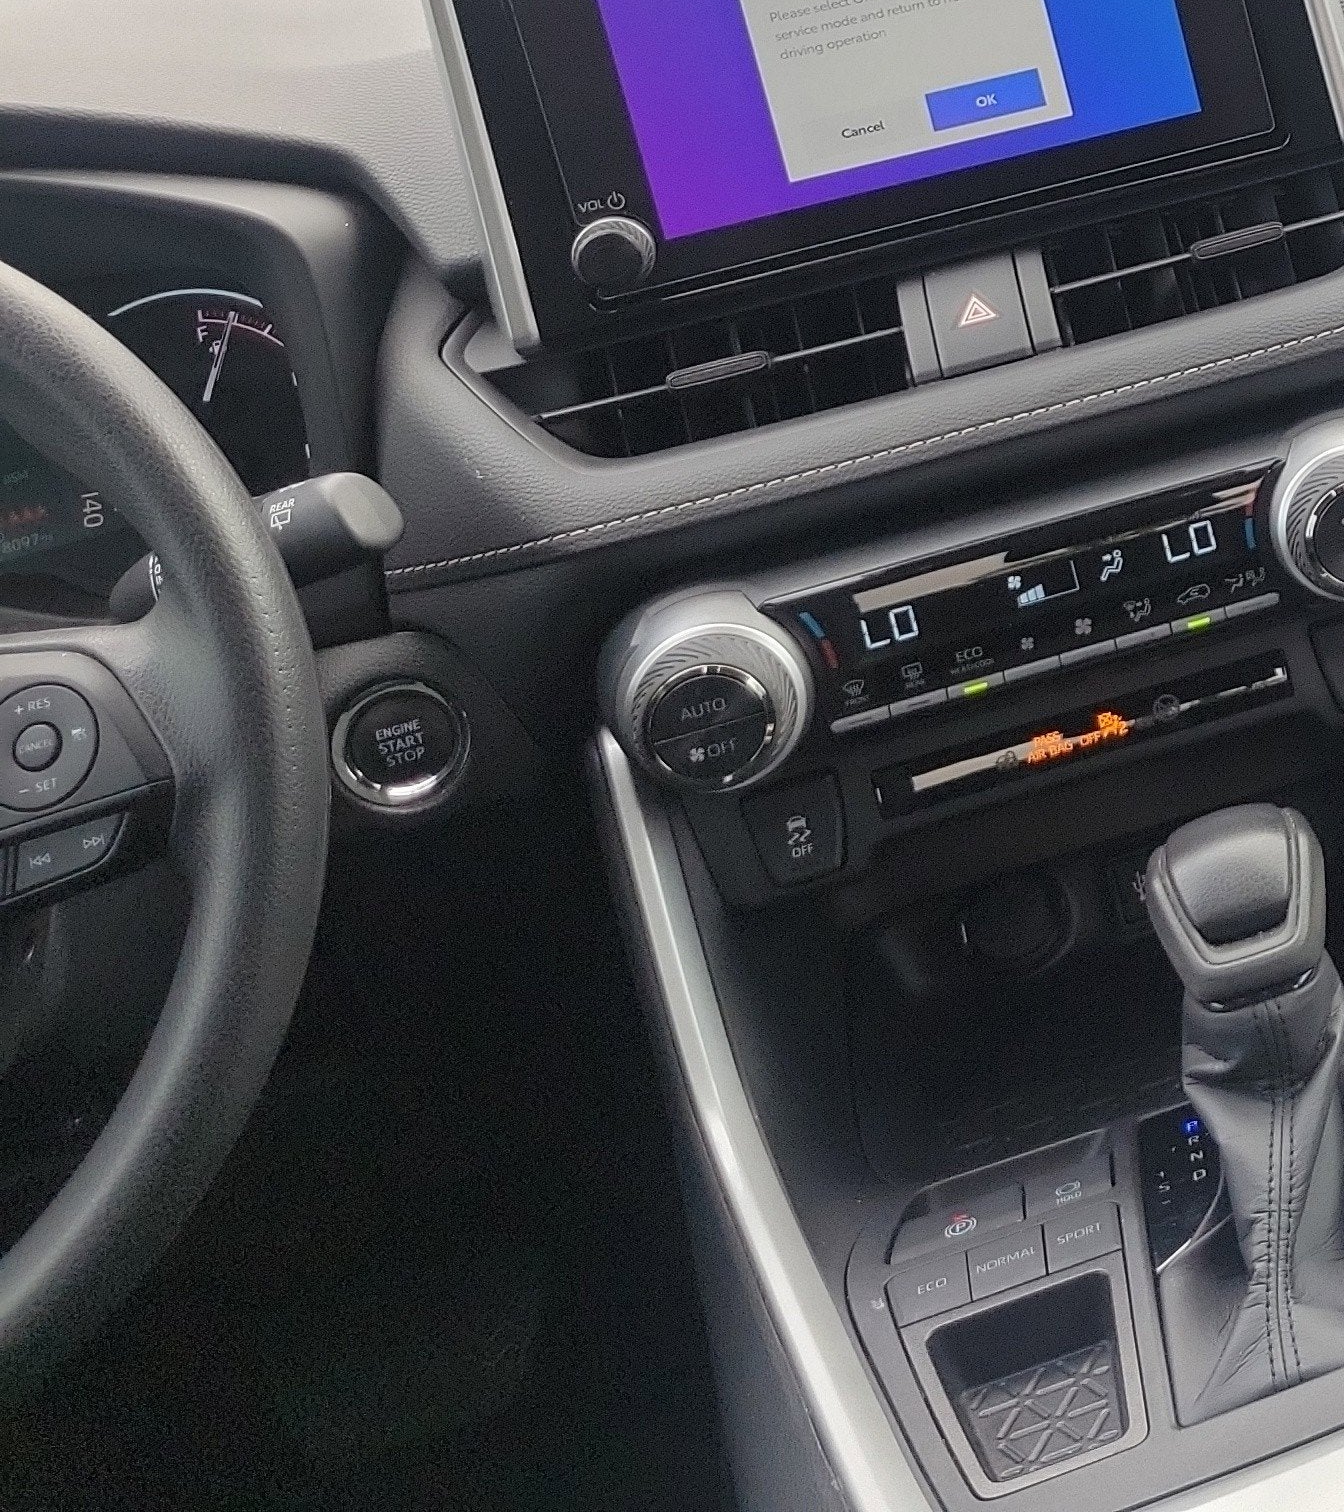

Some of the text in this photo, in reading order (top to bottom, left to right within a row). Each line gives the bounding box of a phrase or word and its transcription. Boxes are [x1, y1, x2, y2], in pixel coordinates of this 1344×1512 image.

[769, 7, 811, 23] Please
[774, 24, 818, 42] service
[820, 15, 858, 33] mode
[860, 7, 885, 24] and
[886, 0, 926, 17] return
[779, 28, 888, 61] driving operation
[974, 92, 998, 109] OK
[841, 120, 886, 140] Cancel
[577, 199, 604, 214] VOL
[196, 324, 209, 343] F
[80, 491, 104, 529] 140
[268, 497, 296, 515] REAR
[954, 645, 984, 664] ECO
[27, 696, 52, 711] RES
[679, 696, 728, 721] AUTO
[375, 718, 421, 742] ENGINE
[378, 731, 424, 755] START
[703, 739, 738, 759] OFF
[1027, 748, 1048, 764] AIR
[1049, 741, 1074, 757] BAG
[386, 745, 426, 768] STOP
[35, 776, 57, 793] SET
[791, 843, 814, 858] OFF
[1055, 1190, 1083, 1207] HOLD
[1056, 1220, 1101, 1247] SPORT
[975, 1245, 1037, 1275] NORMAL
[916, 1276, 948, 1296] ECO
